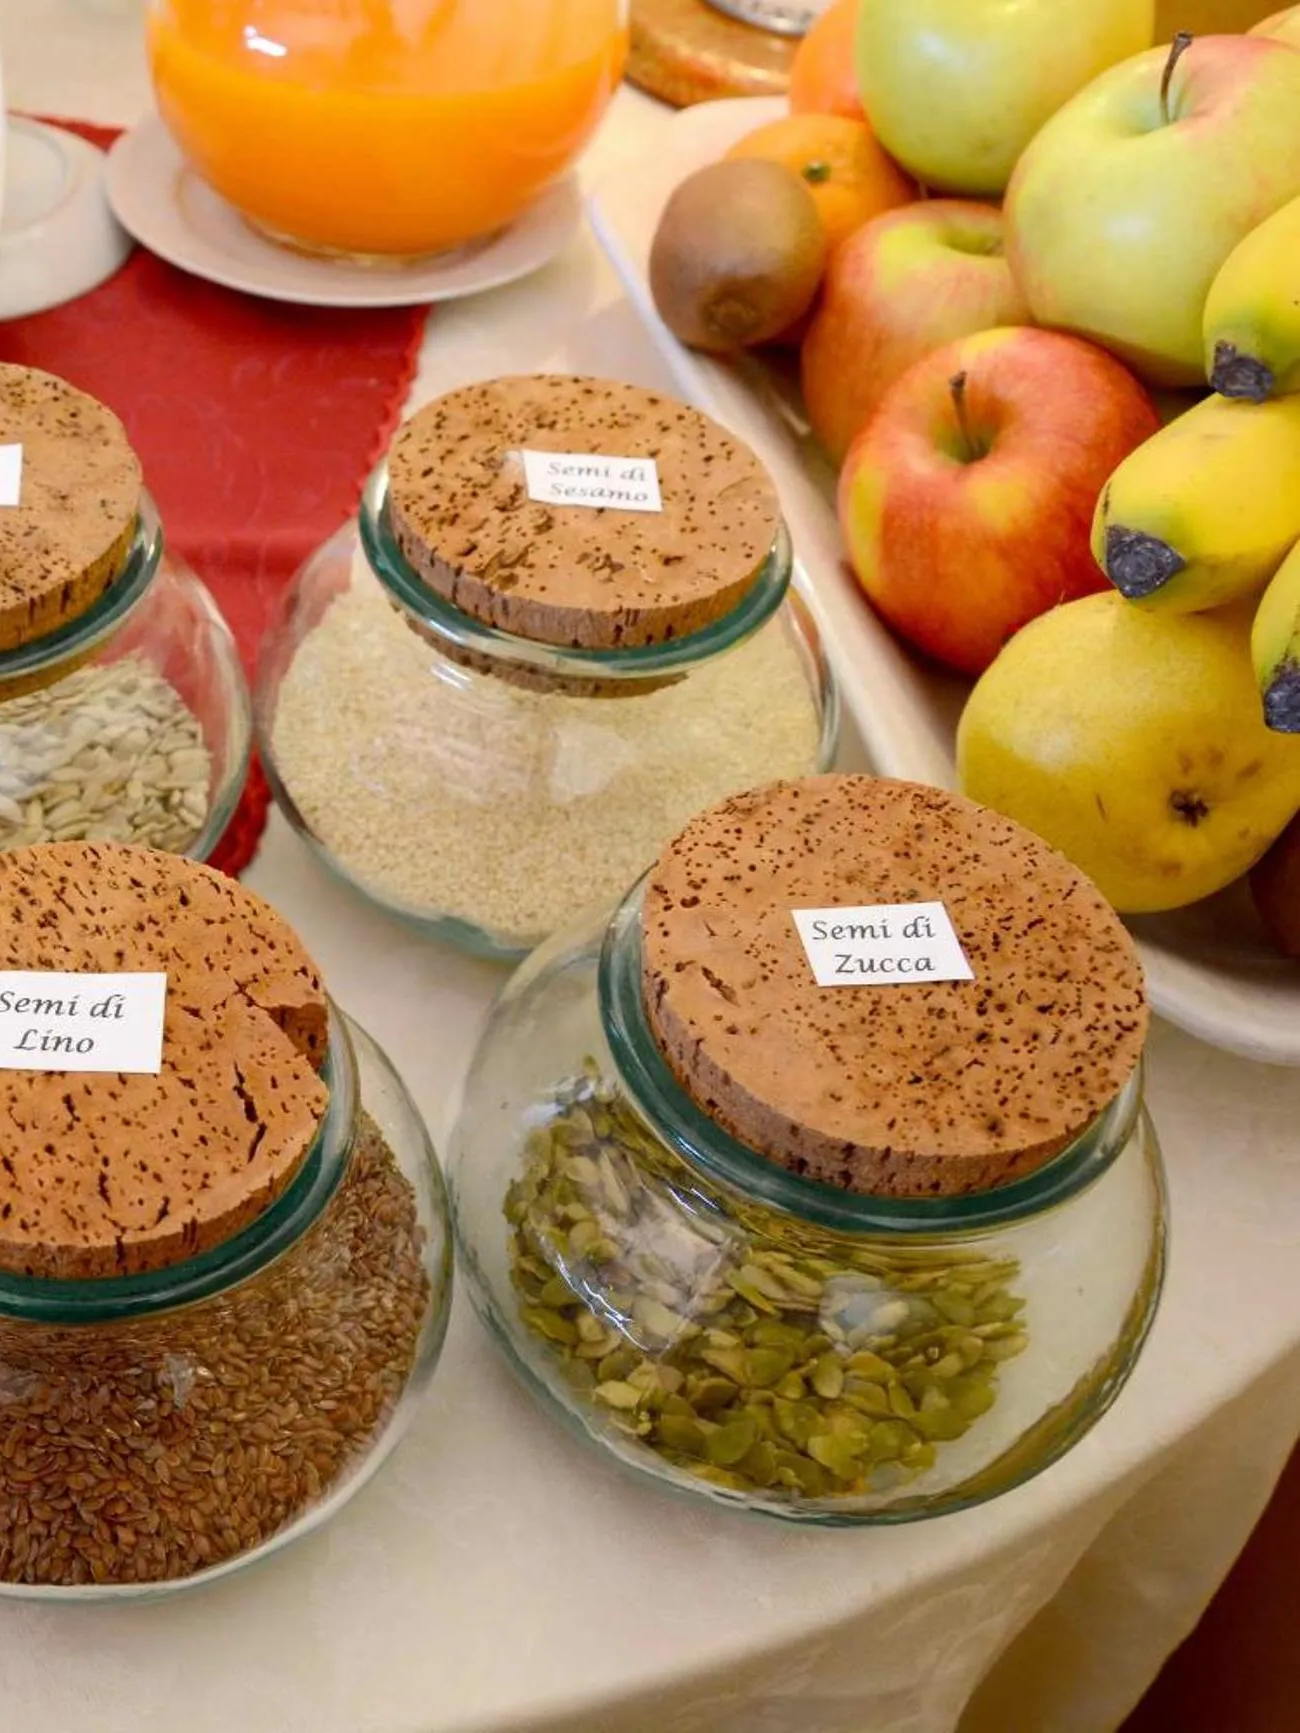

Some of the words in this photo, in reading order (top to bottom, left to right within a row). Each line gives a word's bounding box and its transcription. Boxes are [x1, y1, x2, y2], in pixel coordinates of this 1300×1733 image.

[547, 461, 610, 479] Semi
[620, 466, 646, 482] di
[550, 483, 648, 501] Sesamo
[812, 918, 893, 940] Semi
[902, 916, 936, 939] di
[834, 954, 935, 974] Zucca
[89, 994, 127, 1019] di
[12, 1028, 95, 1054] Lino
